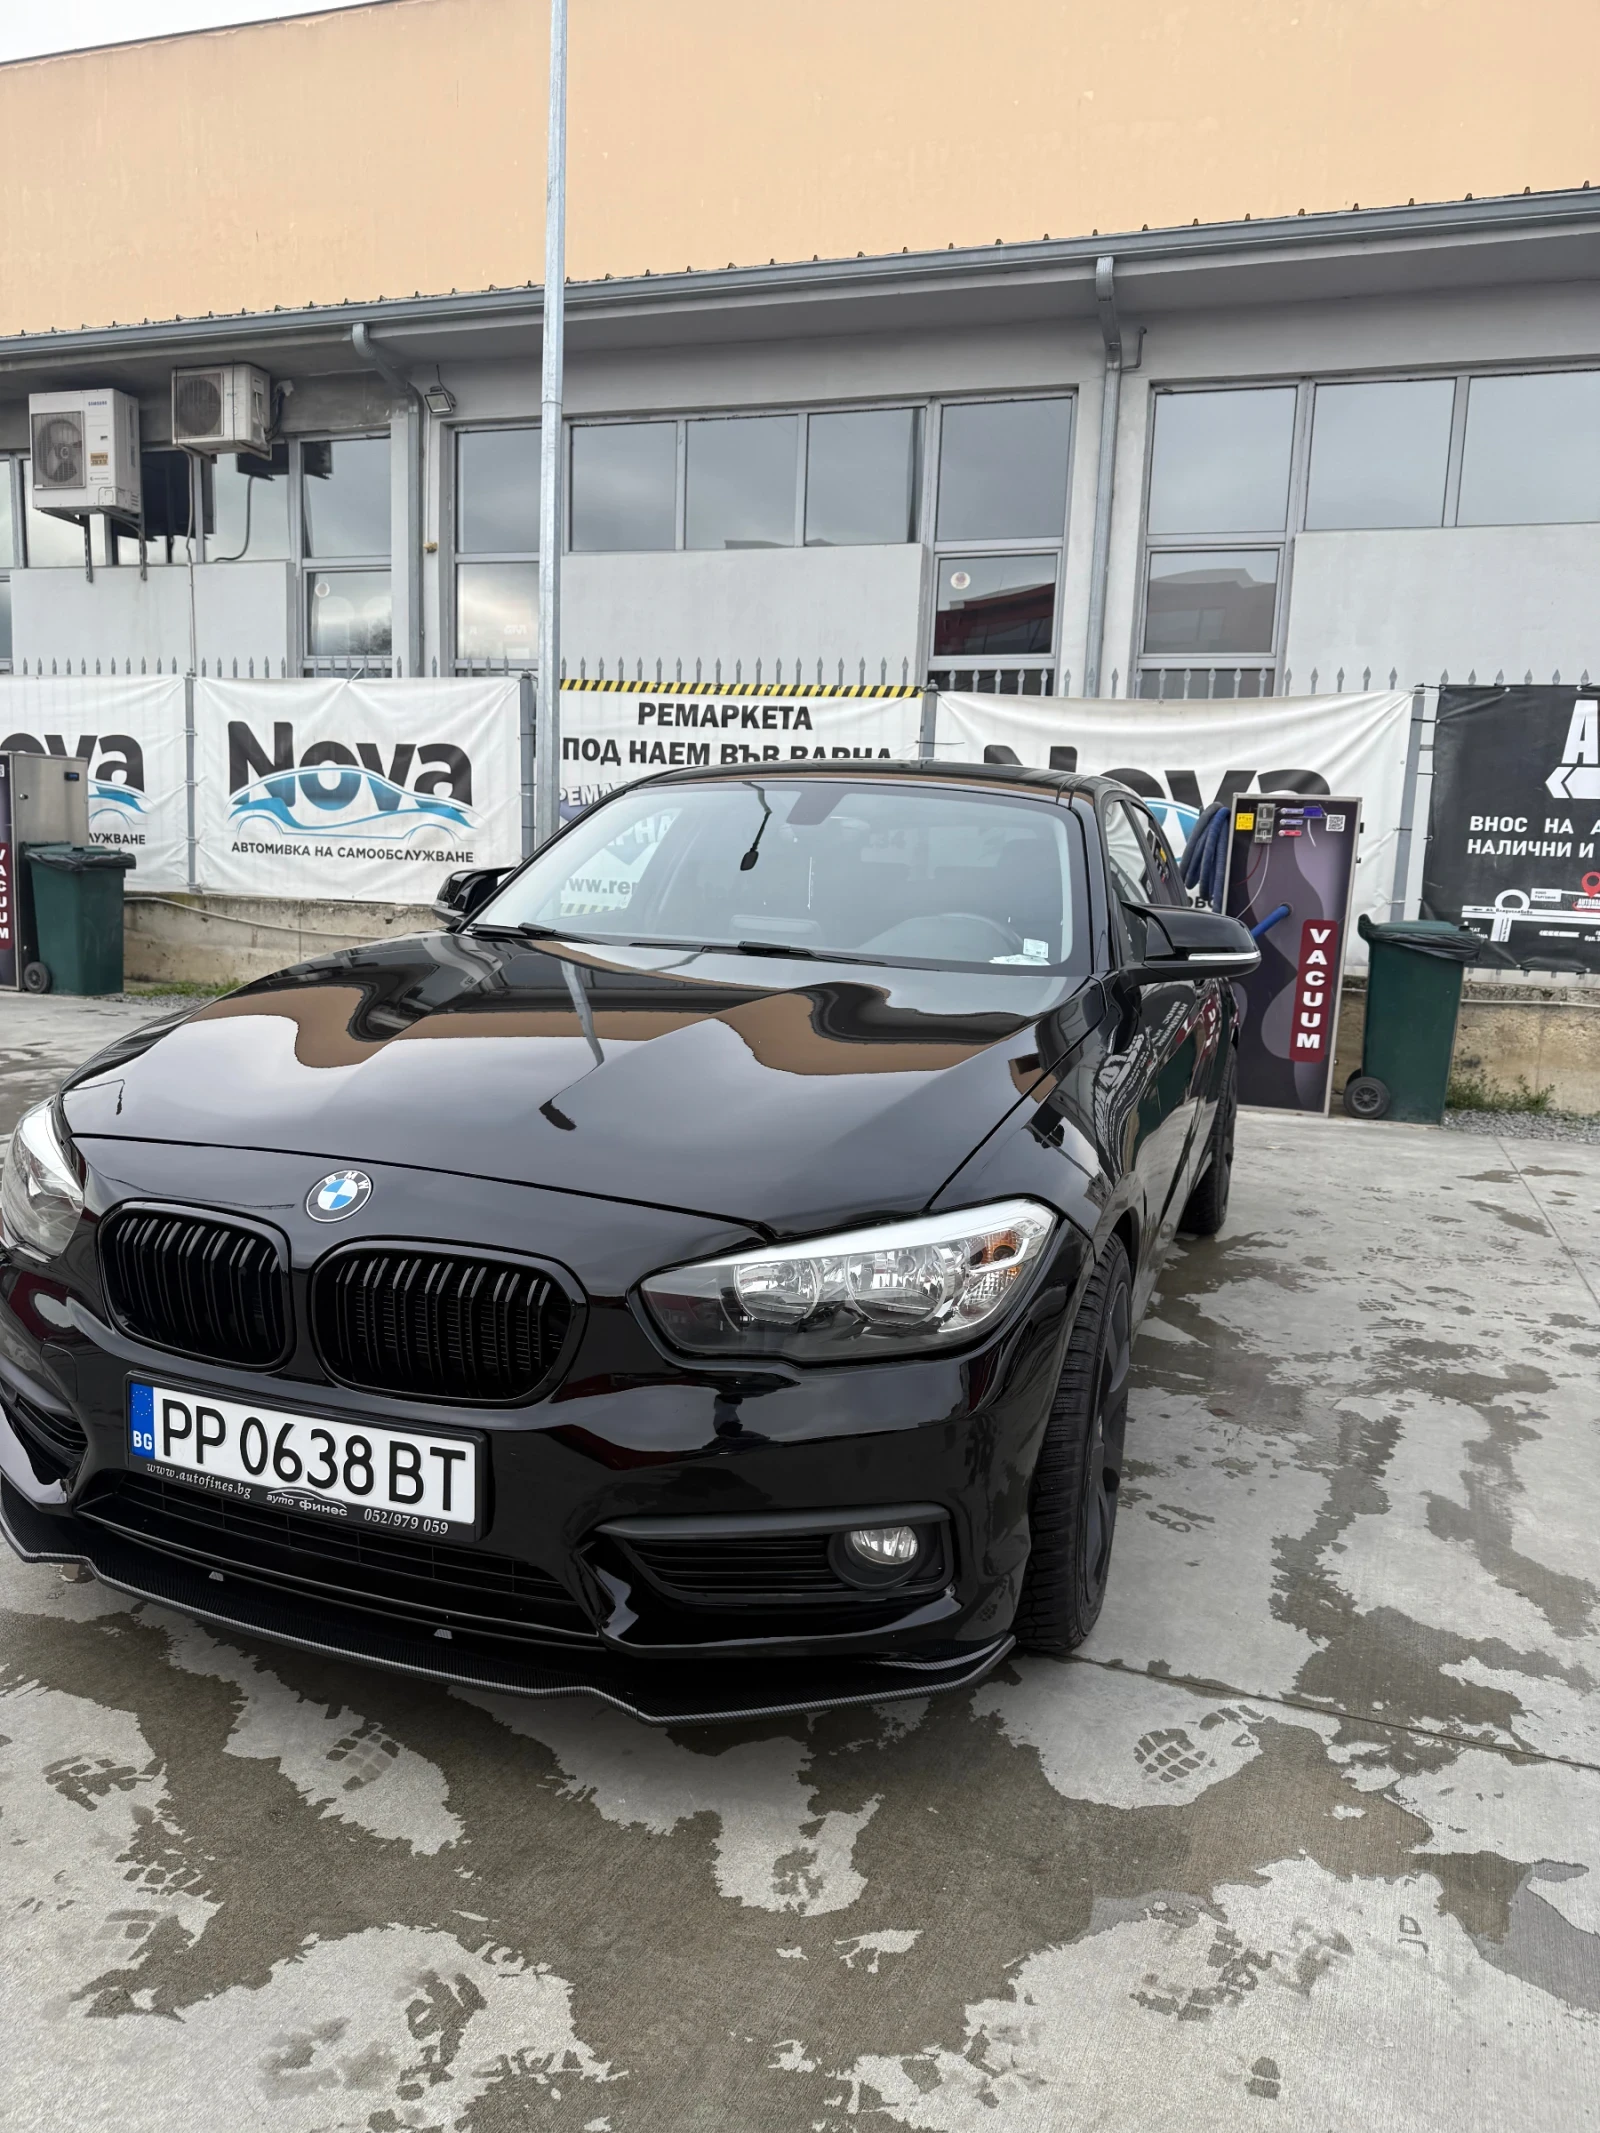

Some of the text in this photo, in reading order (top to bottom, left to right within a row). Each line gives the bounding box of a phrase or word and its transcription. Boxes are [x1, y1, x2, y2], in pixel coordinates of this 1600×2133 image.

[637, 702, 813, 730] РЕМАРКЕТА
[562, 737, 621, 766] ПОД
[629, 740, 710, 766] НАЕМ
[720, 743, 780, 765] ВЪВ
[228, 720, 474, 811] Nova
[1469, 815, 1528, 832] ВНОС
[1544, 818, 1574, 834] НА
[231, 841, 474, 863] АВТОМИВКА НА САМООБСЛУЖВАНЕ
[1467, 839, 1595, 858] НАЛИЧНИ И
[1297, 928, 1331, 1049] VACUUM
[325, 1170, 369, 1190] BMW
[132, 1430, 153, 1450] BG
[162, 1398, 466, 1511] PP 0638 BT
[146, 1462, 252, 1499] www.autofines.bg
[299, 1499, 348, 1517] финес
[364, 1508, 449, 1535] 052/979 059
